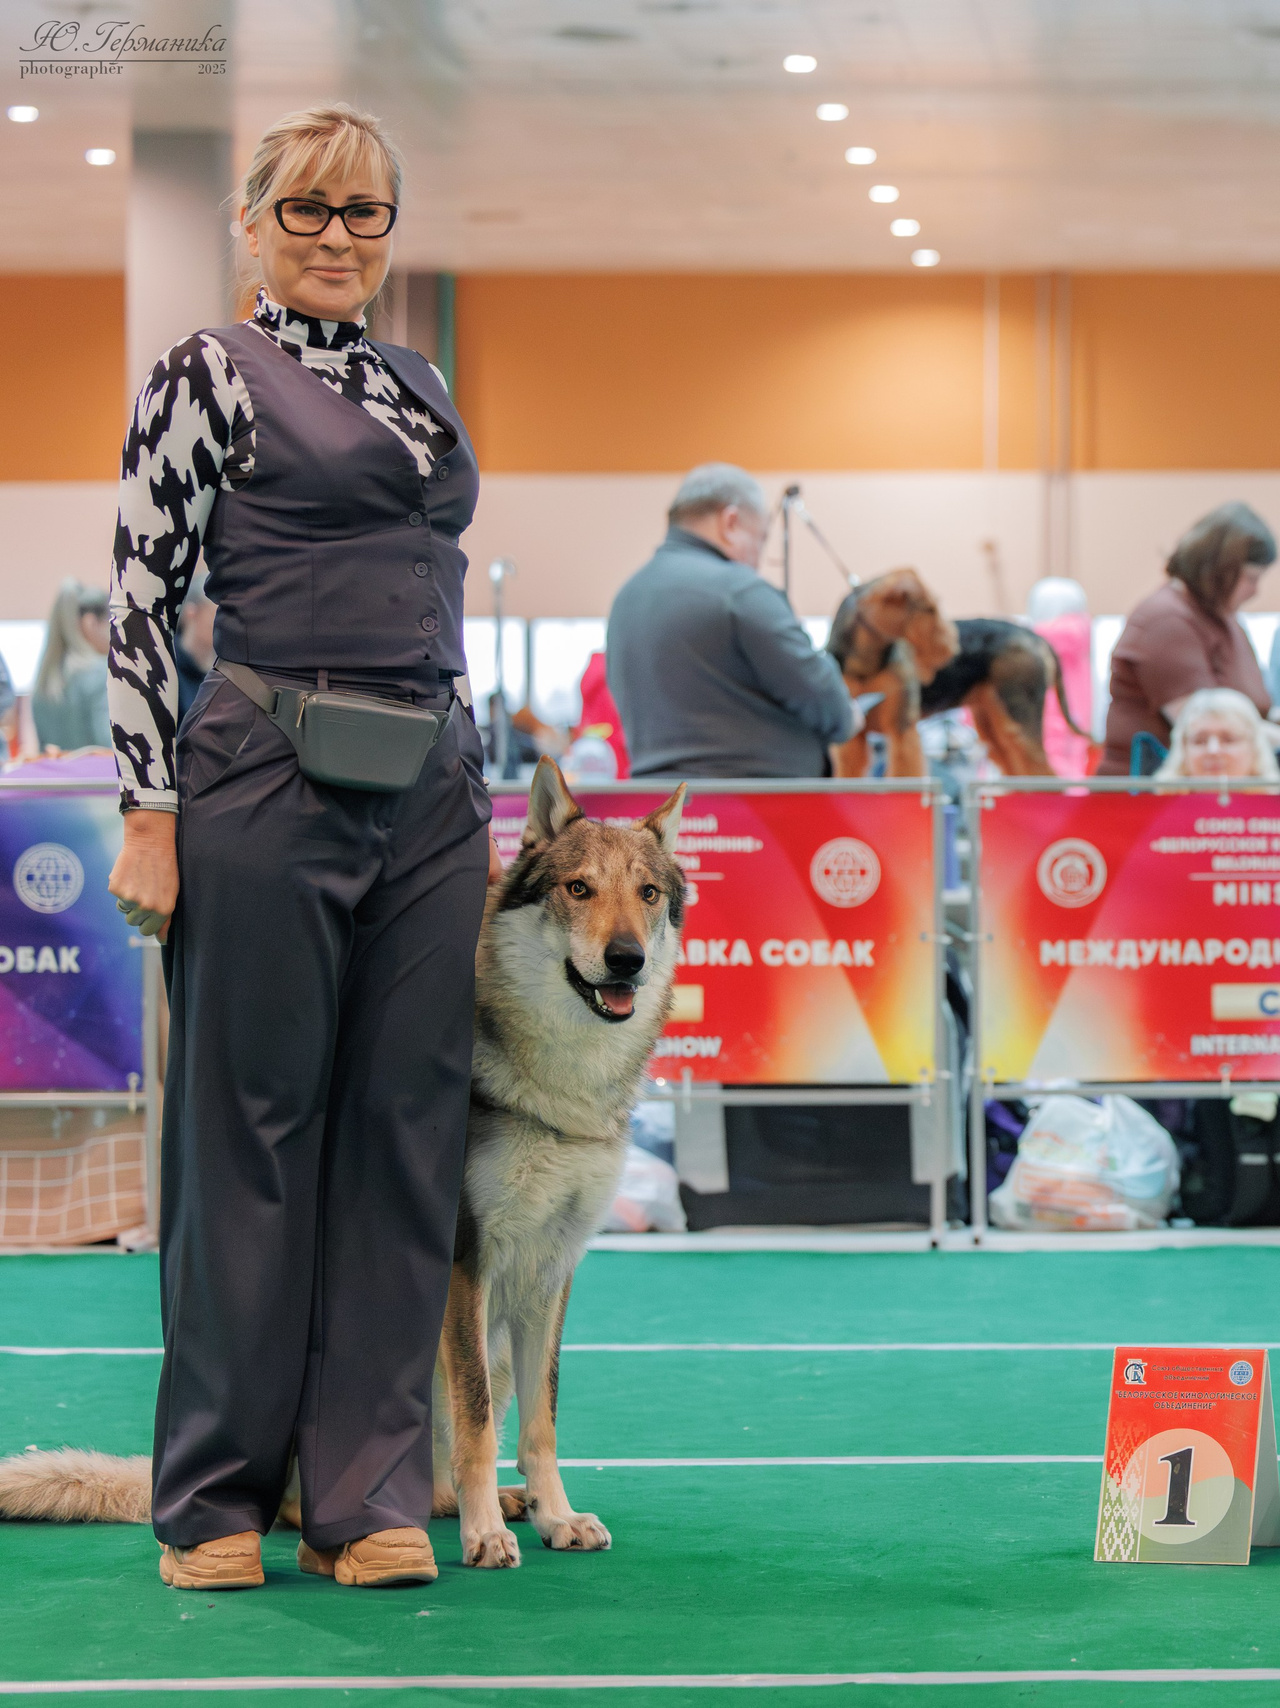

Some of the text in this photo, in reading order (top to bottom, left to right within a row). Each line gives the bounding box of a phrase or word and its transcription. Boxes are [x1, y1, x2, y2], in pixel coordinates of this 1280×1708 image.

[0, 946, 81, 974] ОБАК
[759, 938, 875, 967] СОБАК
[1180, 1391, 1257, 1401] КИНОЛОГИЧЕСКОЕ
[1153, 1447, 1196, 1527] 1
